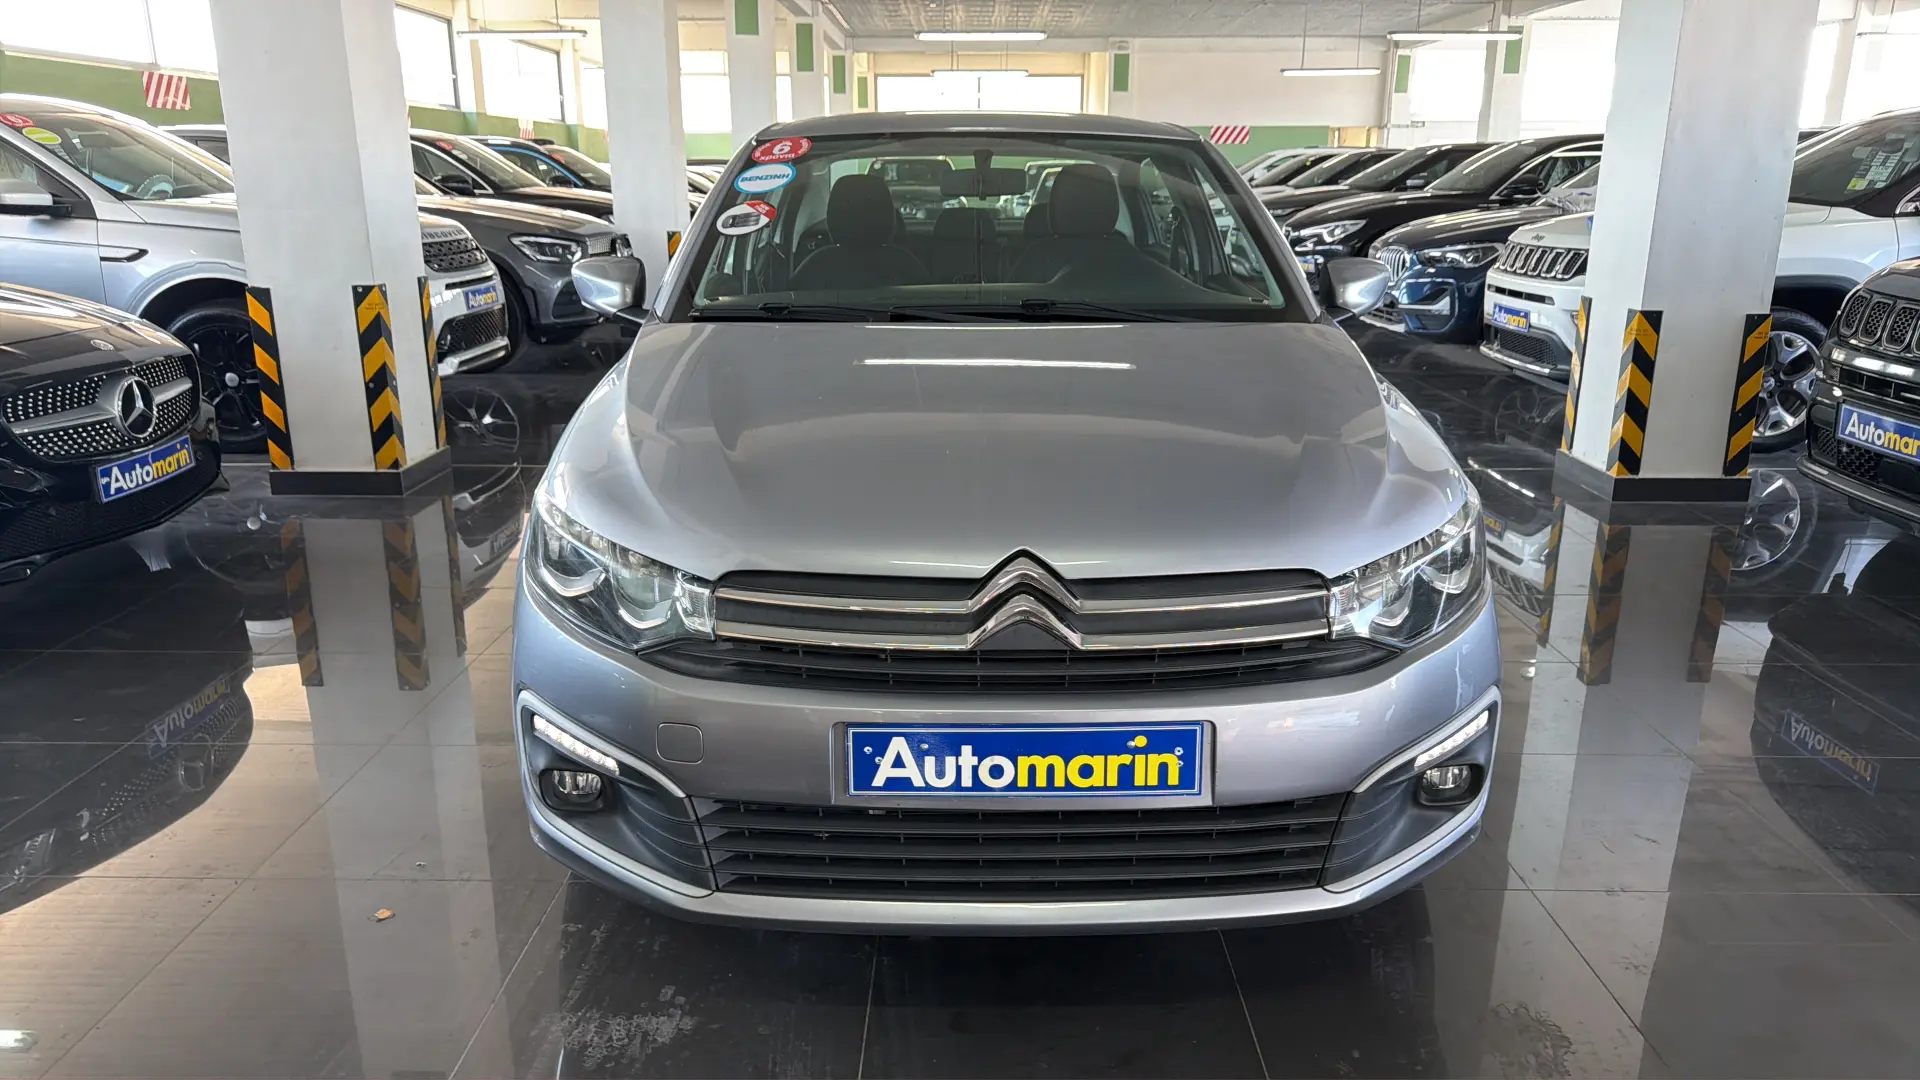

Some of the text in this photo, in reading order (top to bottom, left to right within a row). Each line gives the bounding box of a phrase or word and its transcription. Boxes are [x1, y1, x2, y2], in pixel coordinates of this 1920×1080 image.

[772, 141, 792, 155] 6
[421, 230, 467, 239] ISCOVERY
[1493, 305, 1527, 328] Automarin
[1844, 411, 1920, 456] Automar
[110, 443, 190, 495] Automarin
[871, 736, 1181, 787] Automarin
